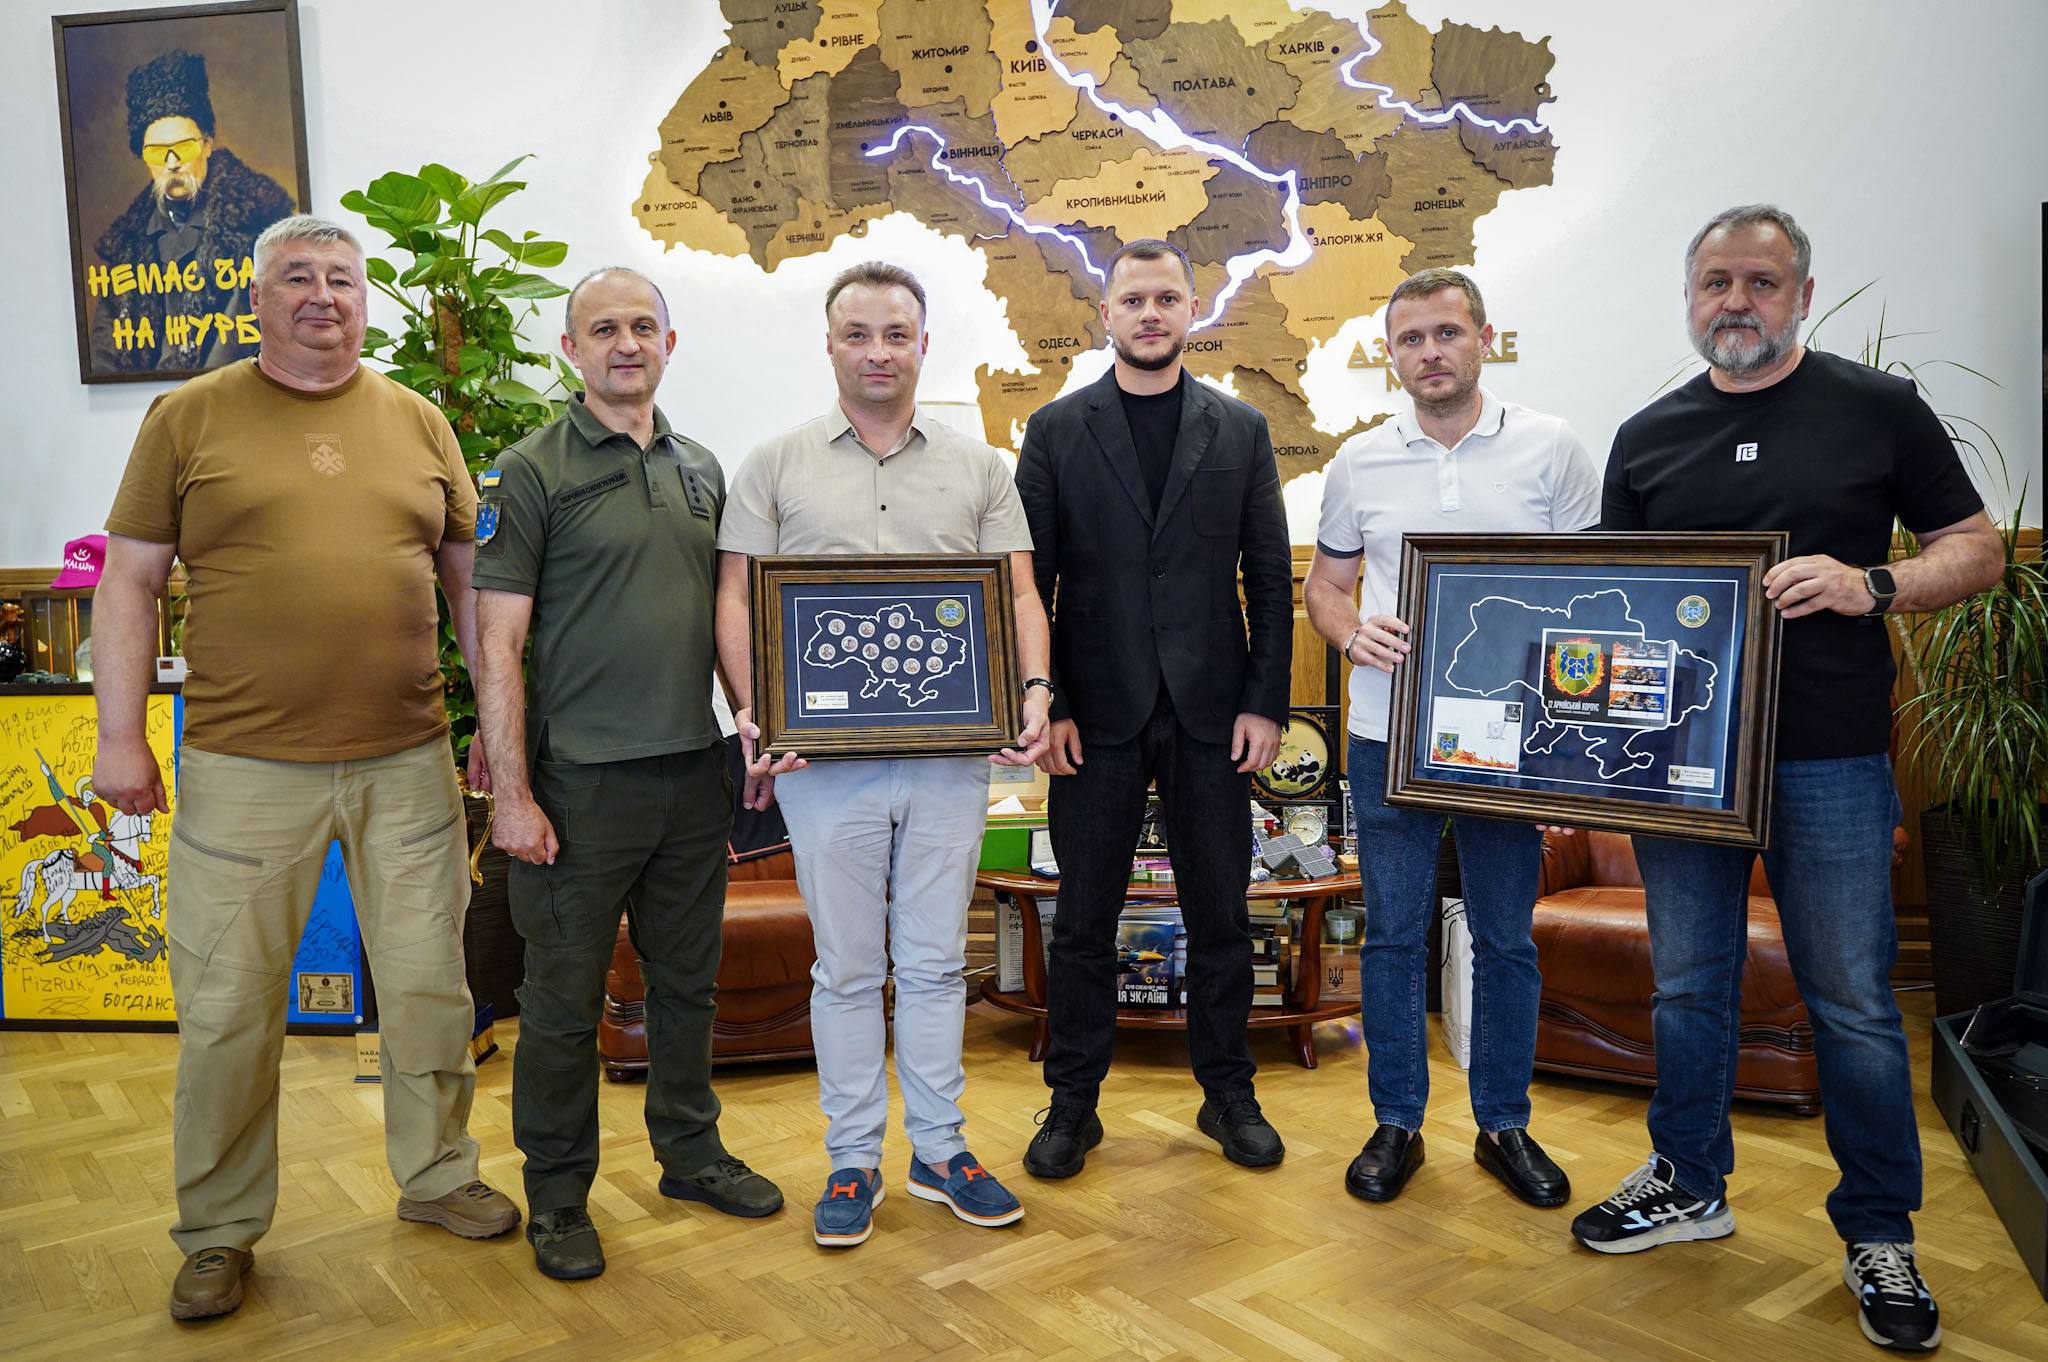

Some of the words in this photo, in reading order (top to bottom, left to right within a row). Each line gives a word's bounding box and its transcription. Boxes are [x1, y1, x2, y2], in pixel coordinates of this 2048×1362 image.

[774, 1, 808, 13] ЛУЦЬК
[831, 35, 865, 47] РІВНЕ
[1279, 41, 1325, 55] ХАРКІВ
[911, 45, 970, 60] ЖИТОМИР
[1010, 56, 1047, 73] КИЇВ
[1173, 76, 1236, 92] ПОЛТАВА
[702, 111, 734, 123] ЛЬВІВ
[835, 116, 902, 130] ХМЕЛЬНИЦЬКИЙ
[1072, 128, 1123, 142] ЧЕРКАСИ
[774, 139, 819, 149] ТЕРНОПІЛЬ
[1493, 139, 1546, 152] ЛУГАНСЬК
[949, 145, 1000, 159] ВІННИЦЯ
[1298, 175, 1353, 192] ДНІПРО
[654, 201, 698, 211] УЖГОРОД
[731, 196, 757, 205] ІВАНО-
[1066, 190, 1166, 210] КРОПИВНИЦЬКИЙ
[1414, 198, 1465, 212] ДОНЕЦЬК
[732, 204, 778, 215] ФРАНКІВСЬК
[786, 232, 825, 244] ЧЕРНІВЦІ
[1313, 232, 1384, 246] ЗАПОРІЖЖЯ
[88, 259, 205, 298] НЕМАЄ
[112, 316, 156, 351] НА
[165, 312, 261, 350] ЖУРБ
[1038, 337, 1081, 350] ОДЕСА
[1183, 340, 1223, 353] РСОН
[103, 992, 176, 1013] БОГДАНС
[1129, 989, 1168, 1004] УКРАЇНИ
